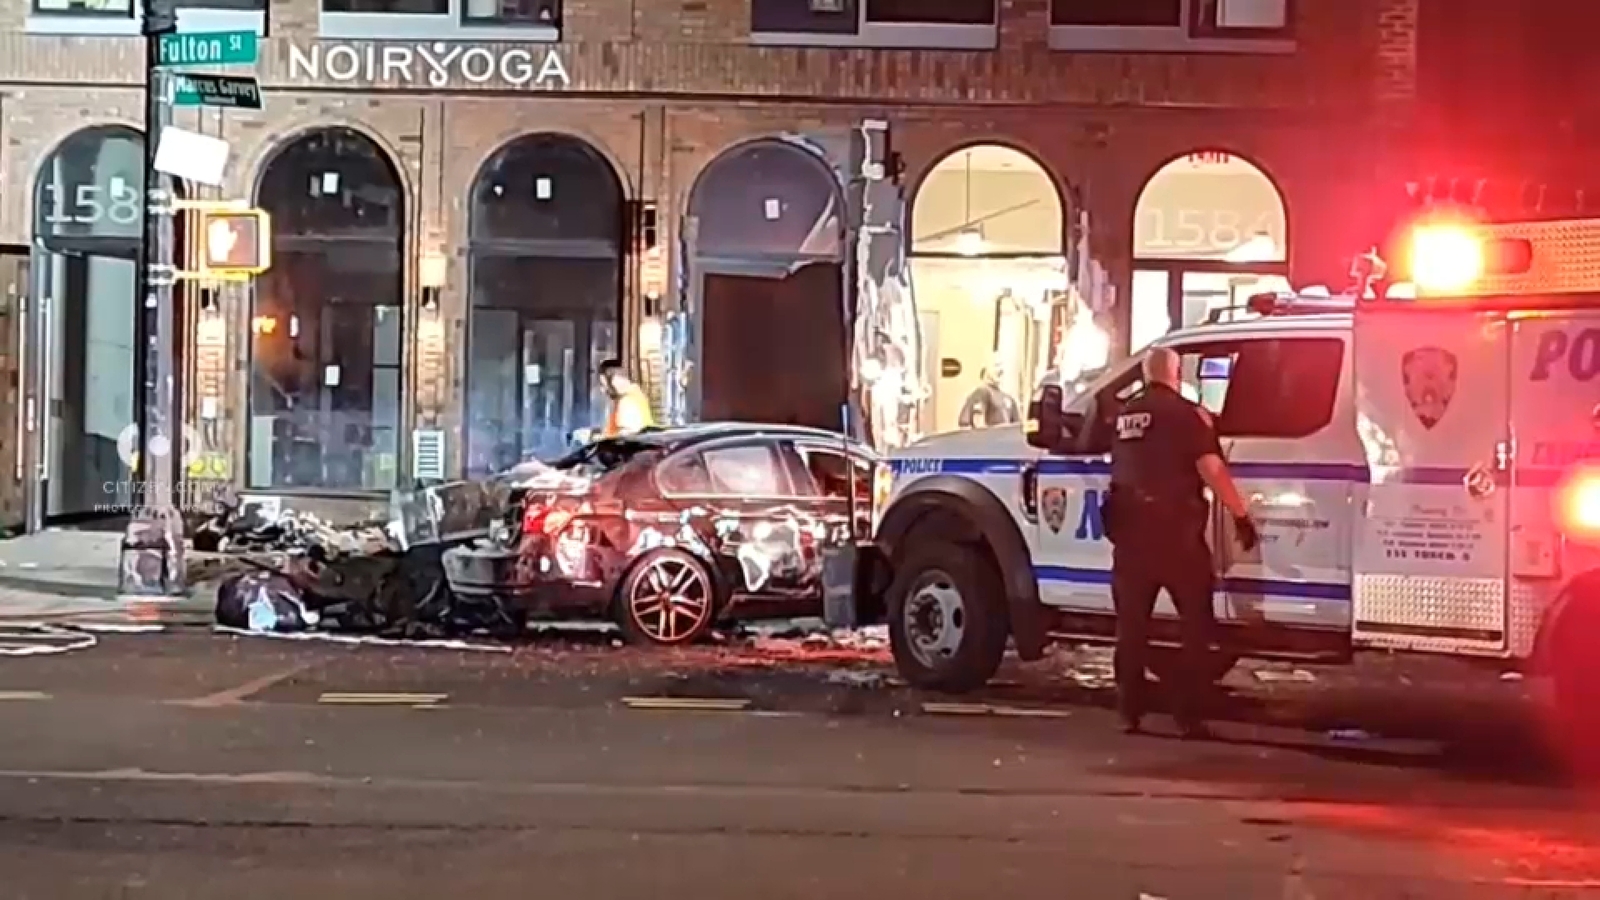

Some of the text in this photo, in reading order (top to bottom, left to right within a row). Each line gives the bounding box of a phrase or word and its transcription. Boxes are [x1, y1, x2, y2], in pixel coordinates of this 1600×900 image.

[160, 35, 222, 62] Fulton
[1116, 413, 1151, 429] NYPD
[900, 458, 943, 474] POLICE
